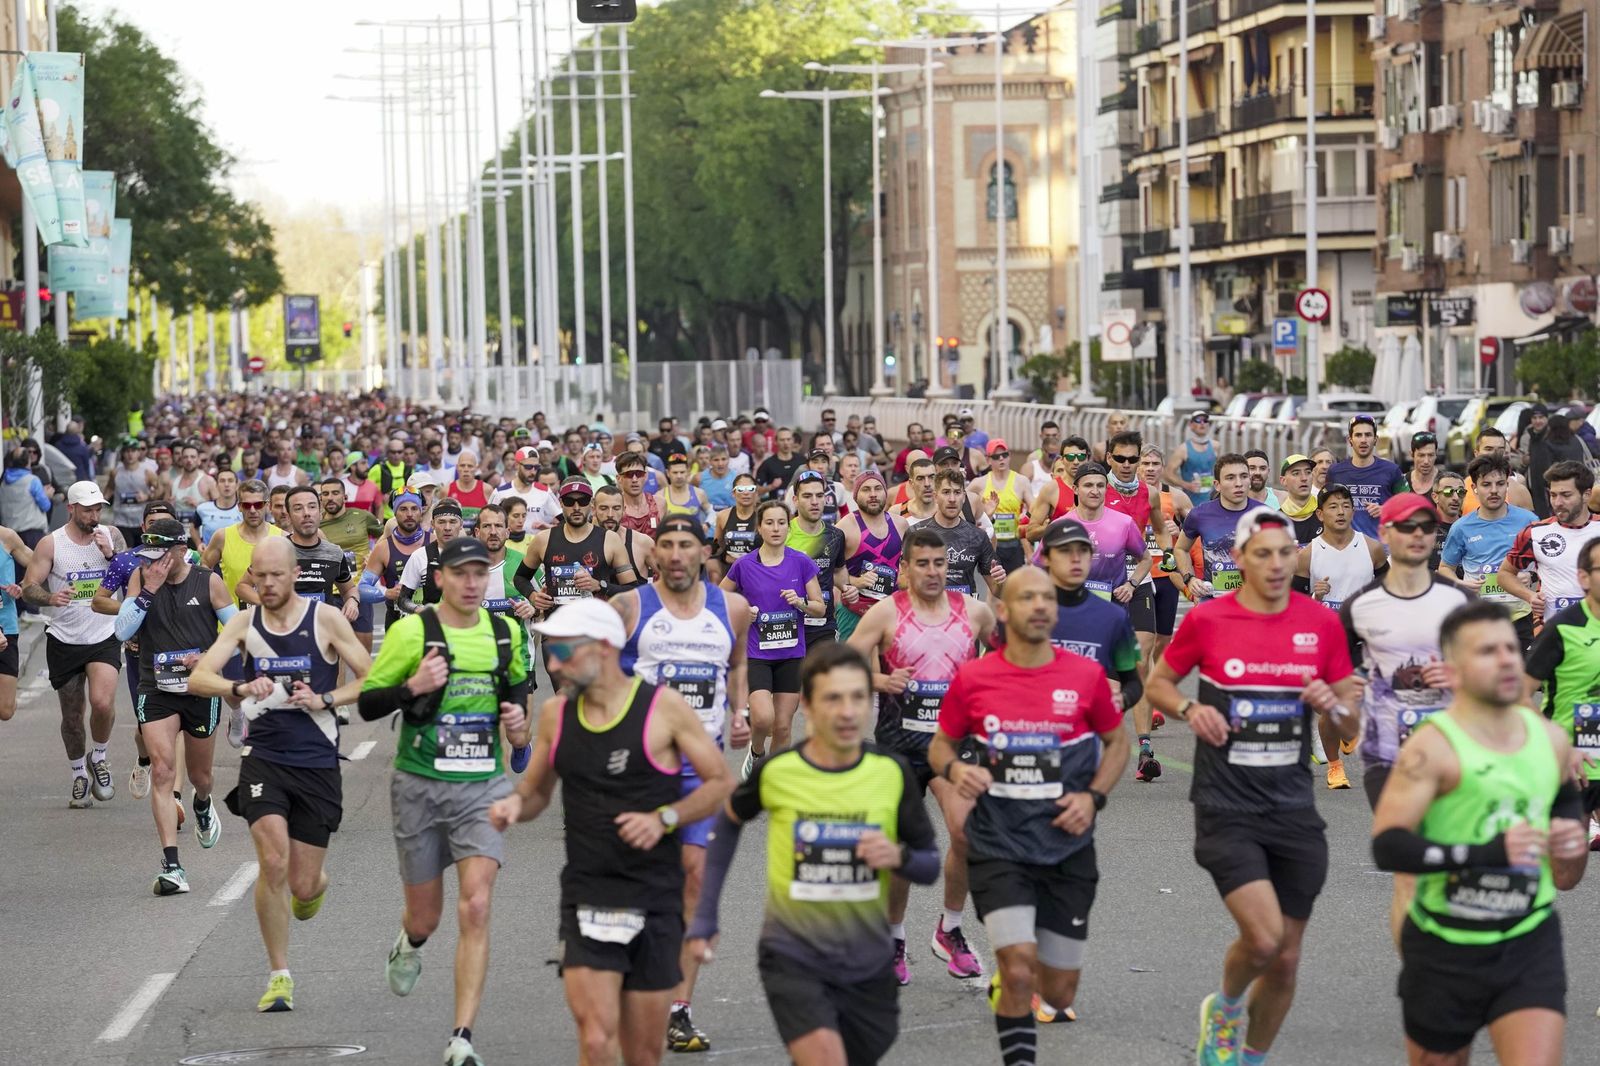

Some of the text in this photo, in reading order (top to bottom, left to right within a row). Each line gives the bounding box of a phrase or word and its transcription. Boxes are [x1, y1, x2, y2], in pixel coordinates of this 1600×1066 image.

[1431, 300, 1470, 310] TINTE
[1084, 582, 1108, 590] ZURICH
[771, 612, 793, 620] ZURICH
[766, 630, 792, 641] SARAH
[271, 658, 305, 668] ZURICH
[678, 667, 714, 676] ZURICH
[1246, 662, 1319, 677] outsystems
[1255, 702, 1297, 714] ZURICH
[1001, 719, 1074, 732] outsystems
[1010, 737, 1044, 747] ZURICH
[444, 742, 489, 757] GAËTAN
[798, 861, 854, 883] SUPER
